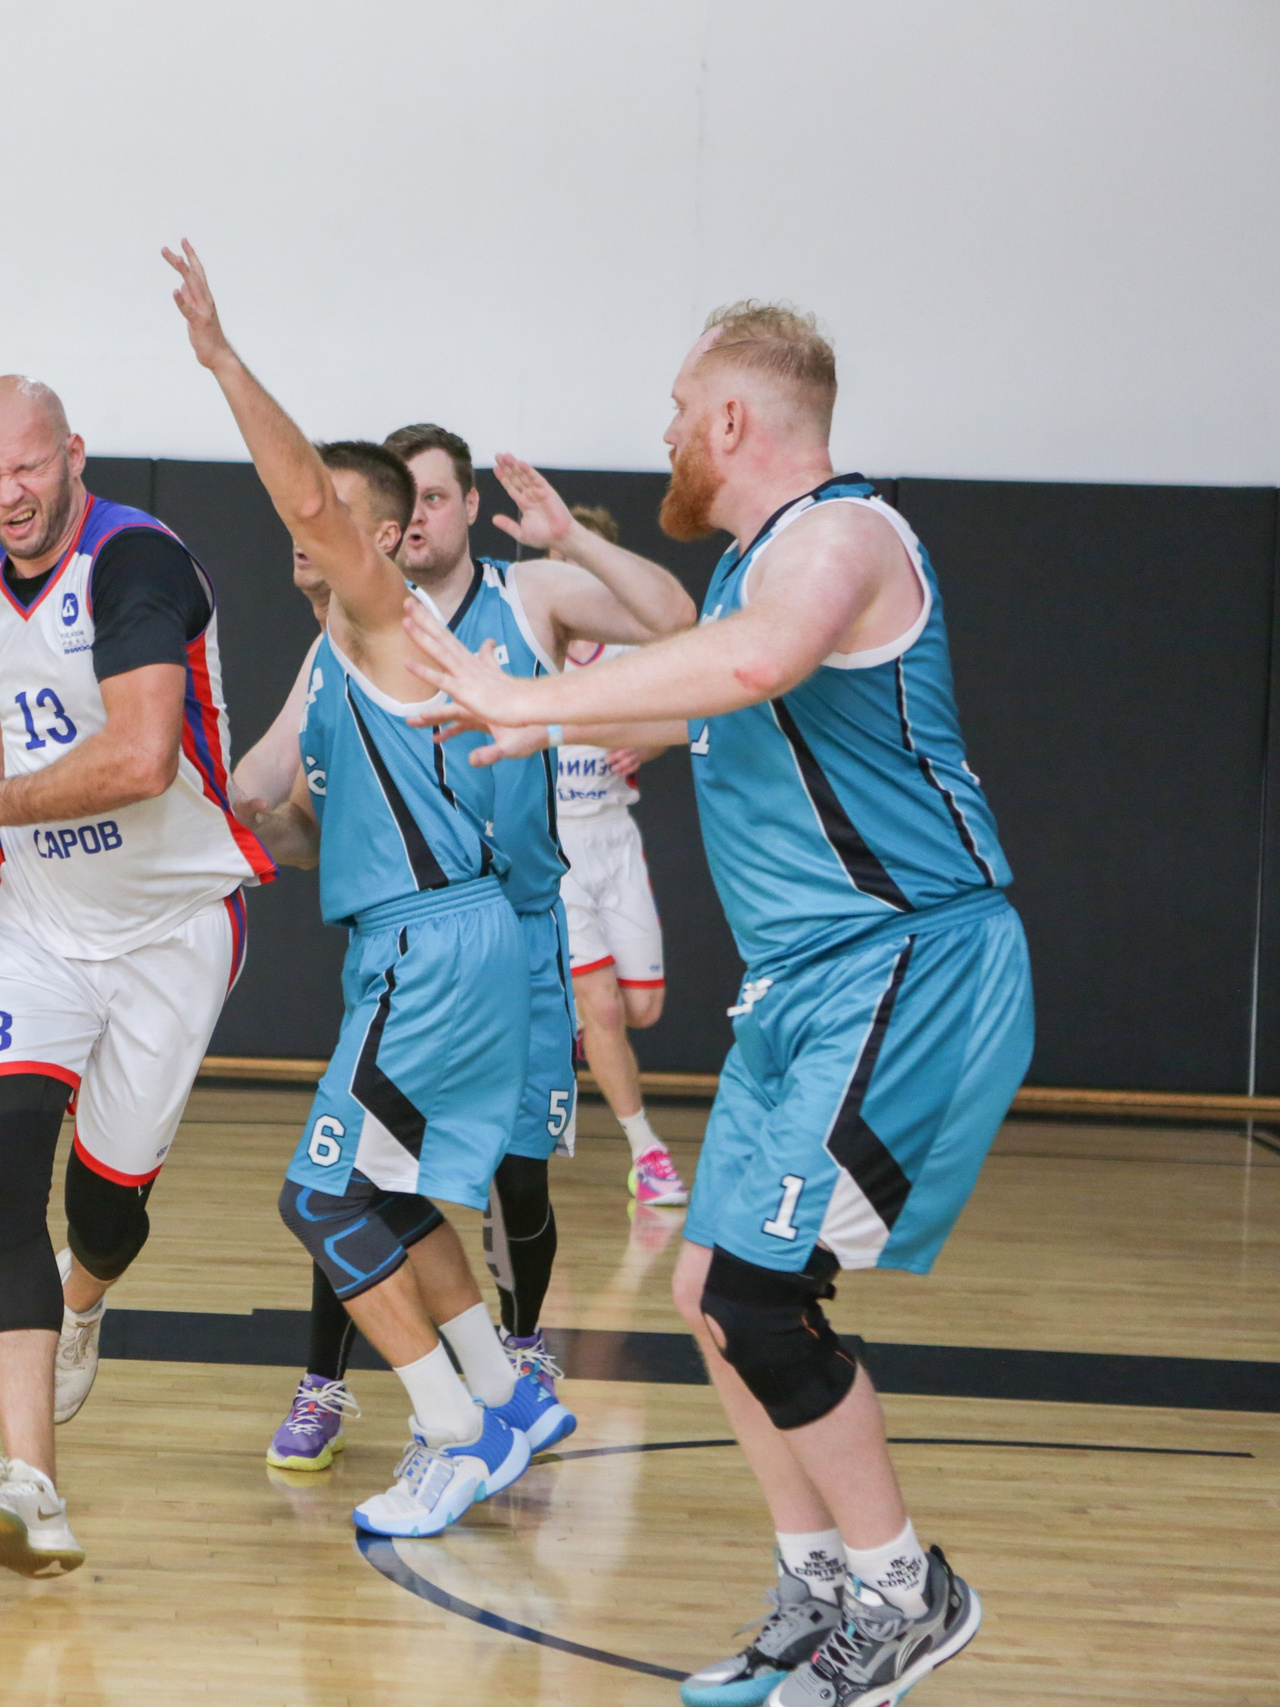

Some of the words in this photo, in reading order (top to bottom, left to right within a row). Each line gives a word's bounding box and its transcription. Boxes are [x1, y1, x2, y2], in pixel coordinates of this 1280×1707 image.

[14, 687, 78, 750] 13
[33, 820, 123, 859] САРОВ
[307, 1113, 346, 1168] 6
[546, 1089, 571, 1138] 5
[761, 1173, 806, 1242] 1
